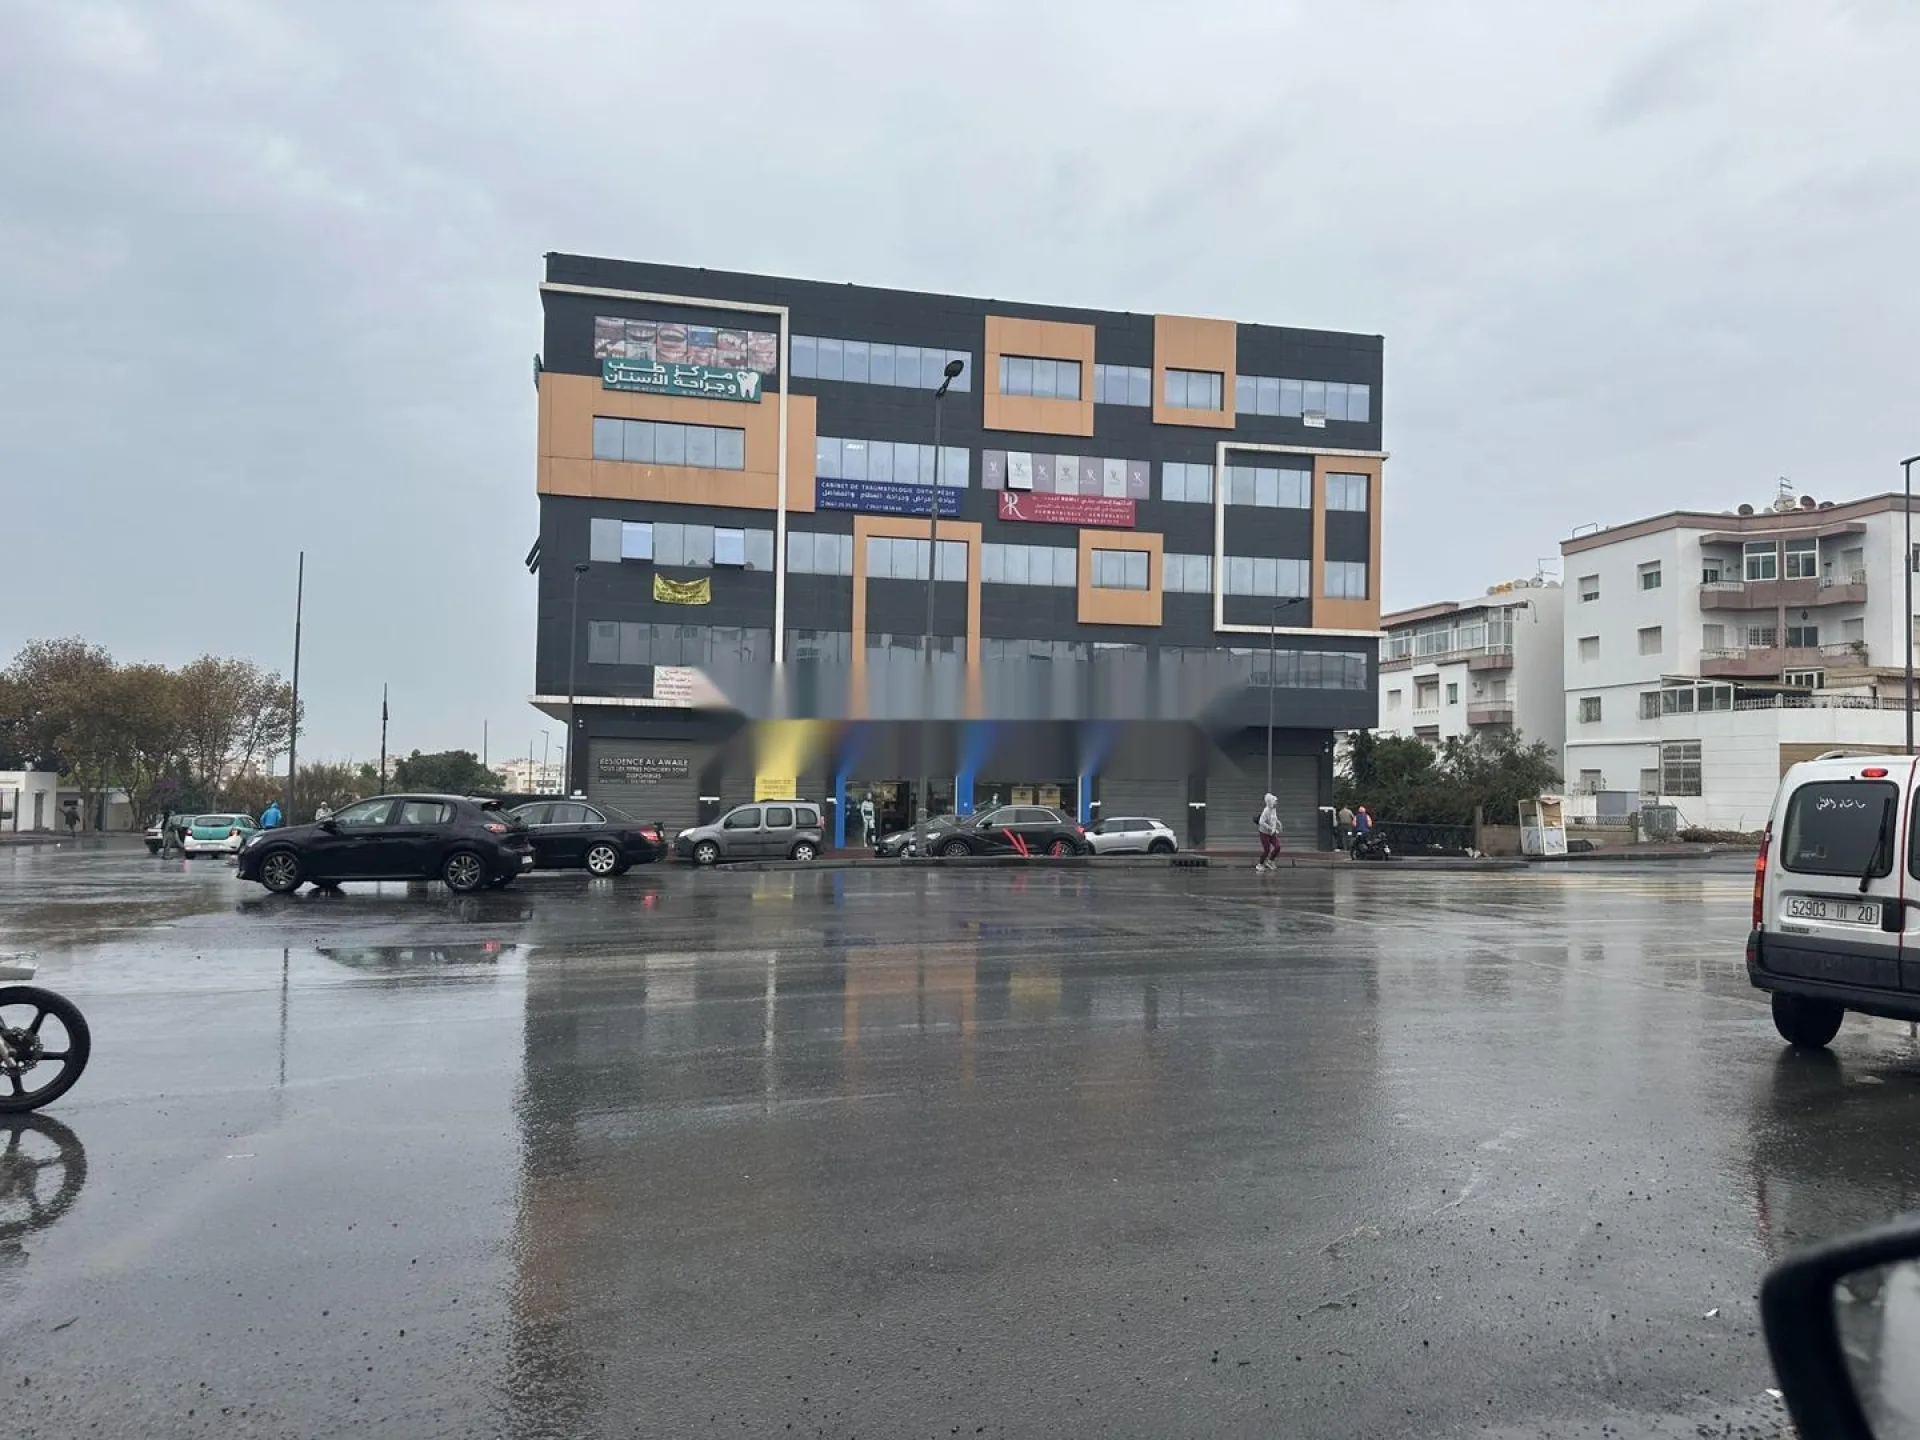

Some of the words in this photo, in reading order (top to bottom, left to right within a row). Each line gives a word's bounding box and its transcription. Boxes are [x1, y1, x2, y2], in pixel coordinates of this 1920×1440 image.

[608, 361, 666, 374] طب
[674, 364, 733, 380] مركز
[604, 370, 669, 386] الأسنان
[673, 378, 737, 394] وجراحة
[646, 758, 657, 766] AL
[1792, 900, 1826, 917] 52903
[1858, 906, 1873, 922] 20
